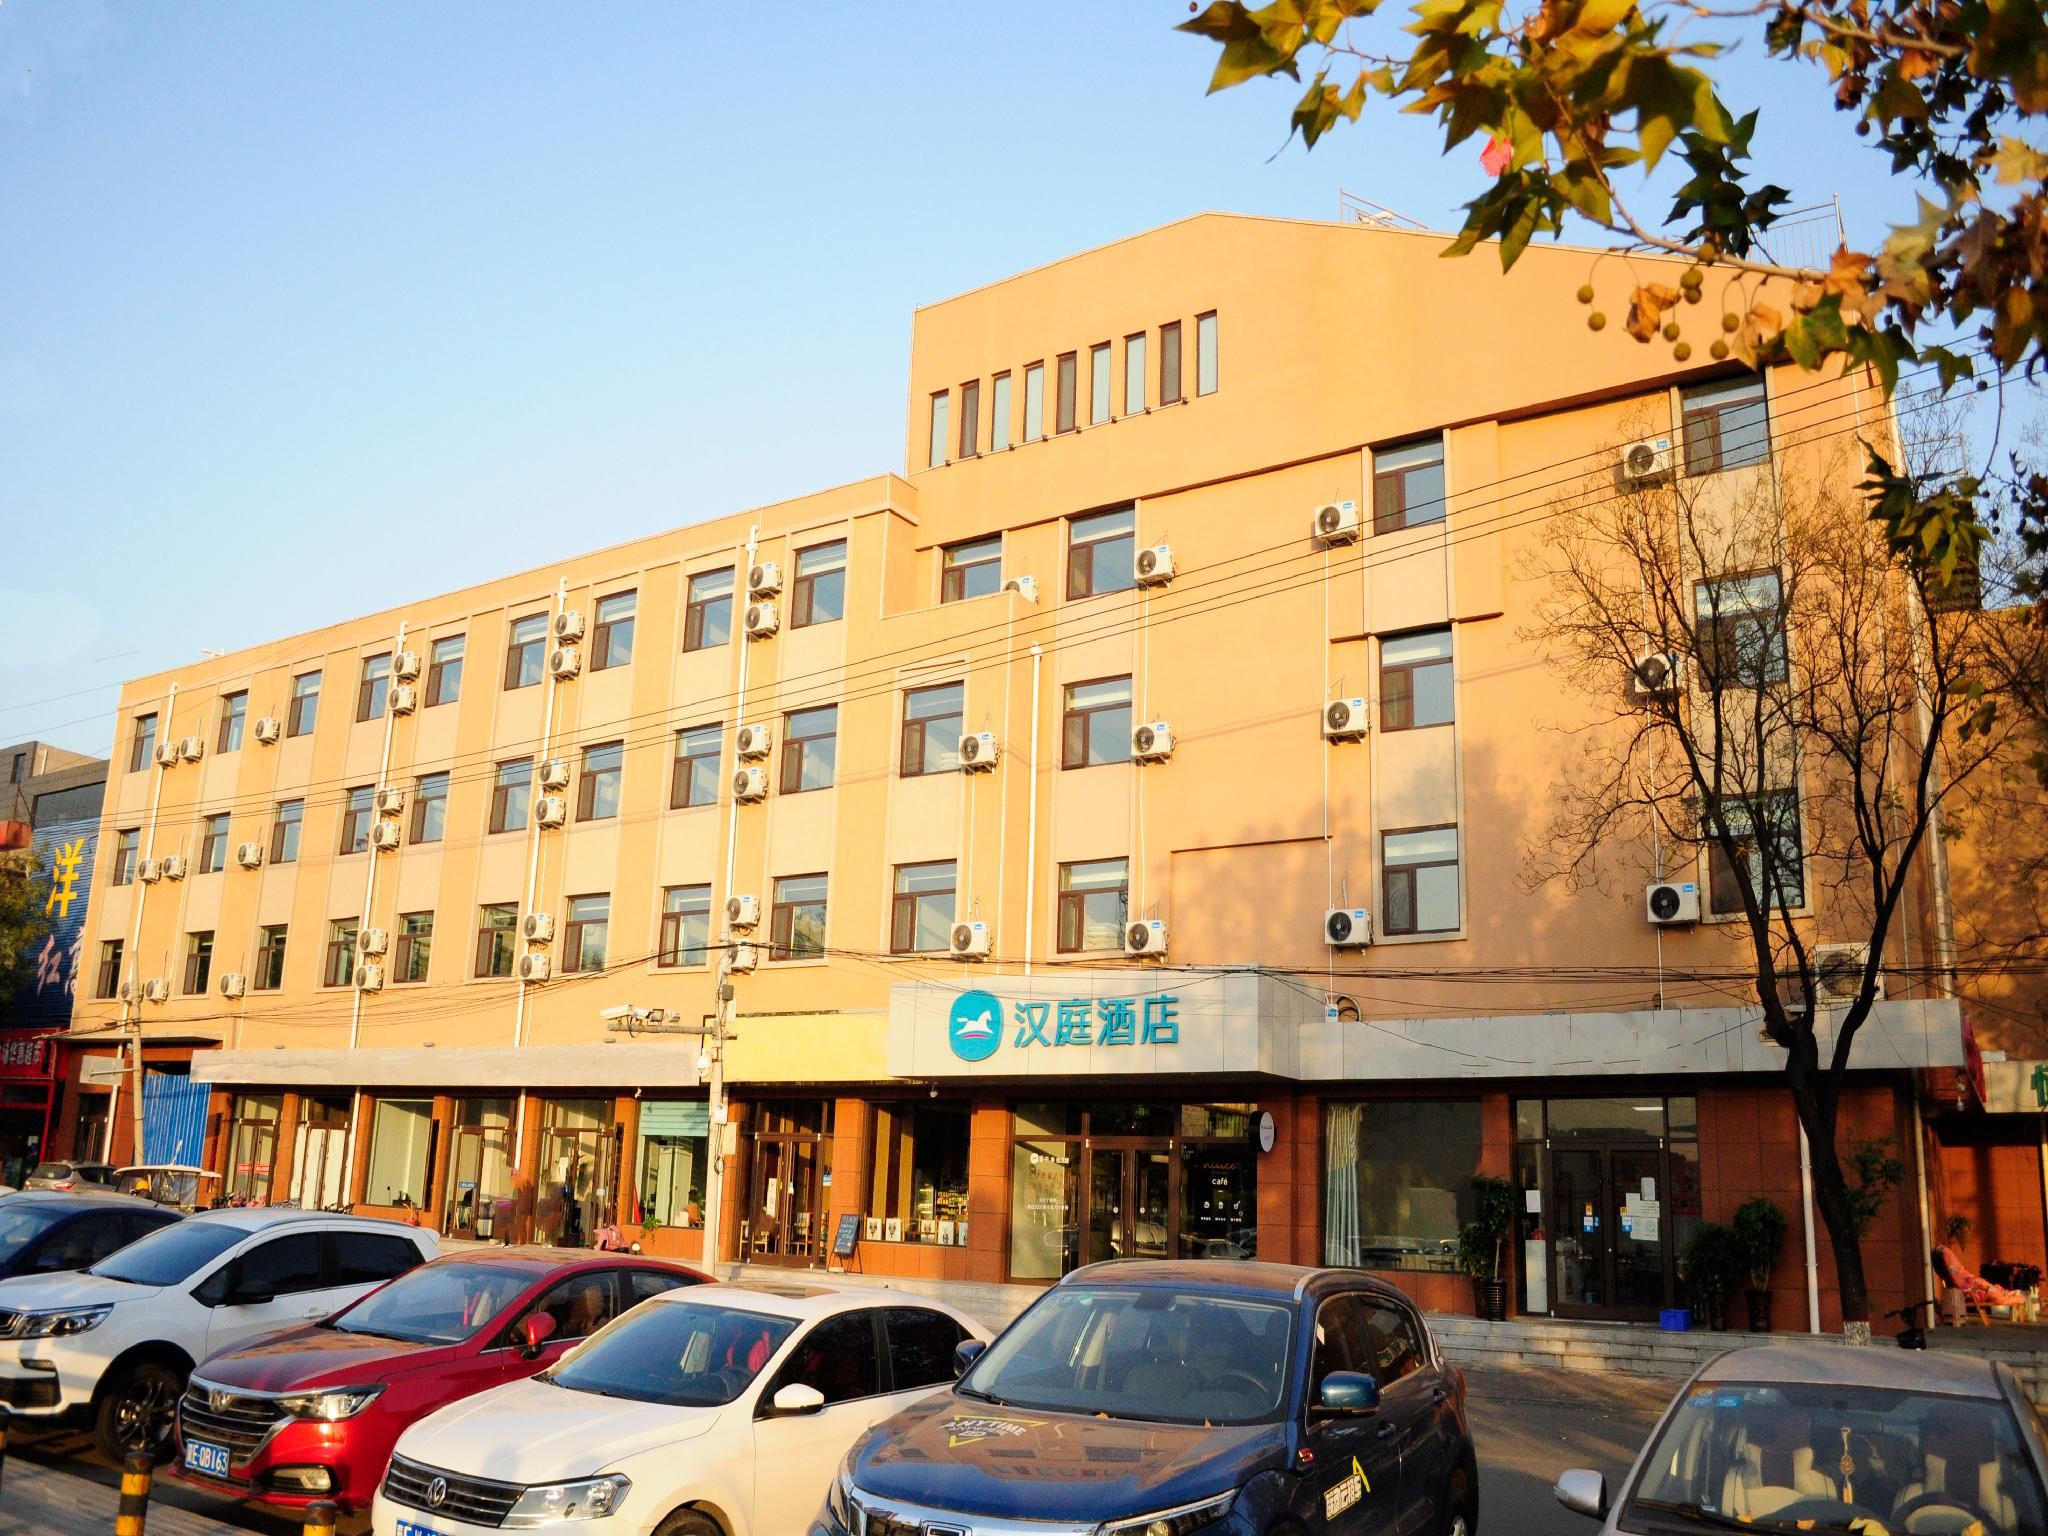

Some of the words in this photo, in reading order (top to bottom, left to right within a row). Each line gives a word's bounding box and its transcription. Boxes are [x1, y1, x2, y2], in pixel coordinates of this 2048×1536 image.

[46, 838, 85, 918] 洋
[1013, 994, 1180, 1047] 汉庭酒店
[1212, 1177, 1228, 1186] café
[939, 1420, 1027, 1437] ANYTIME
